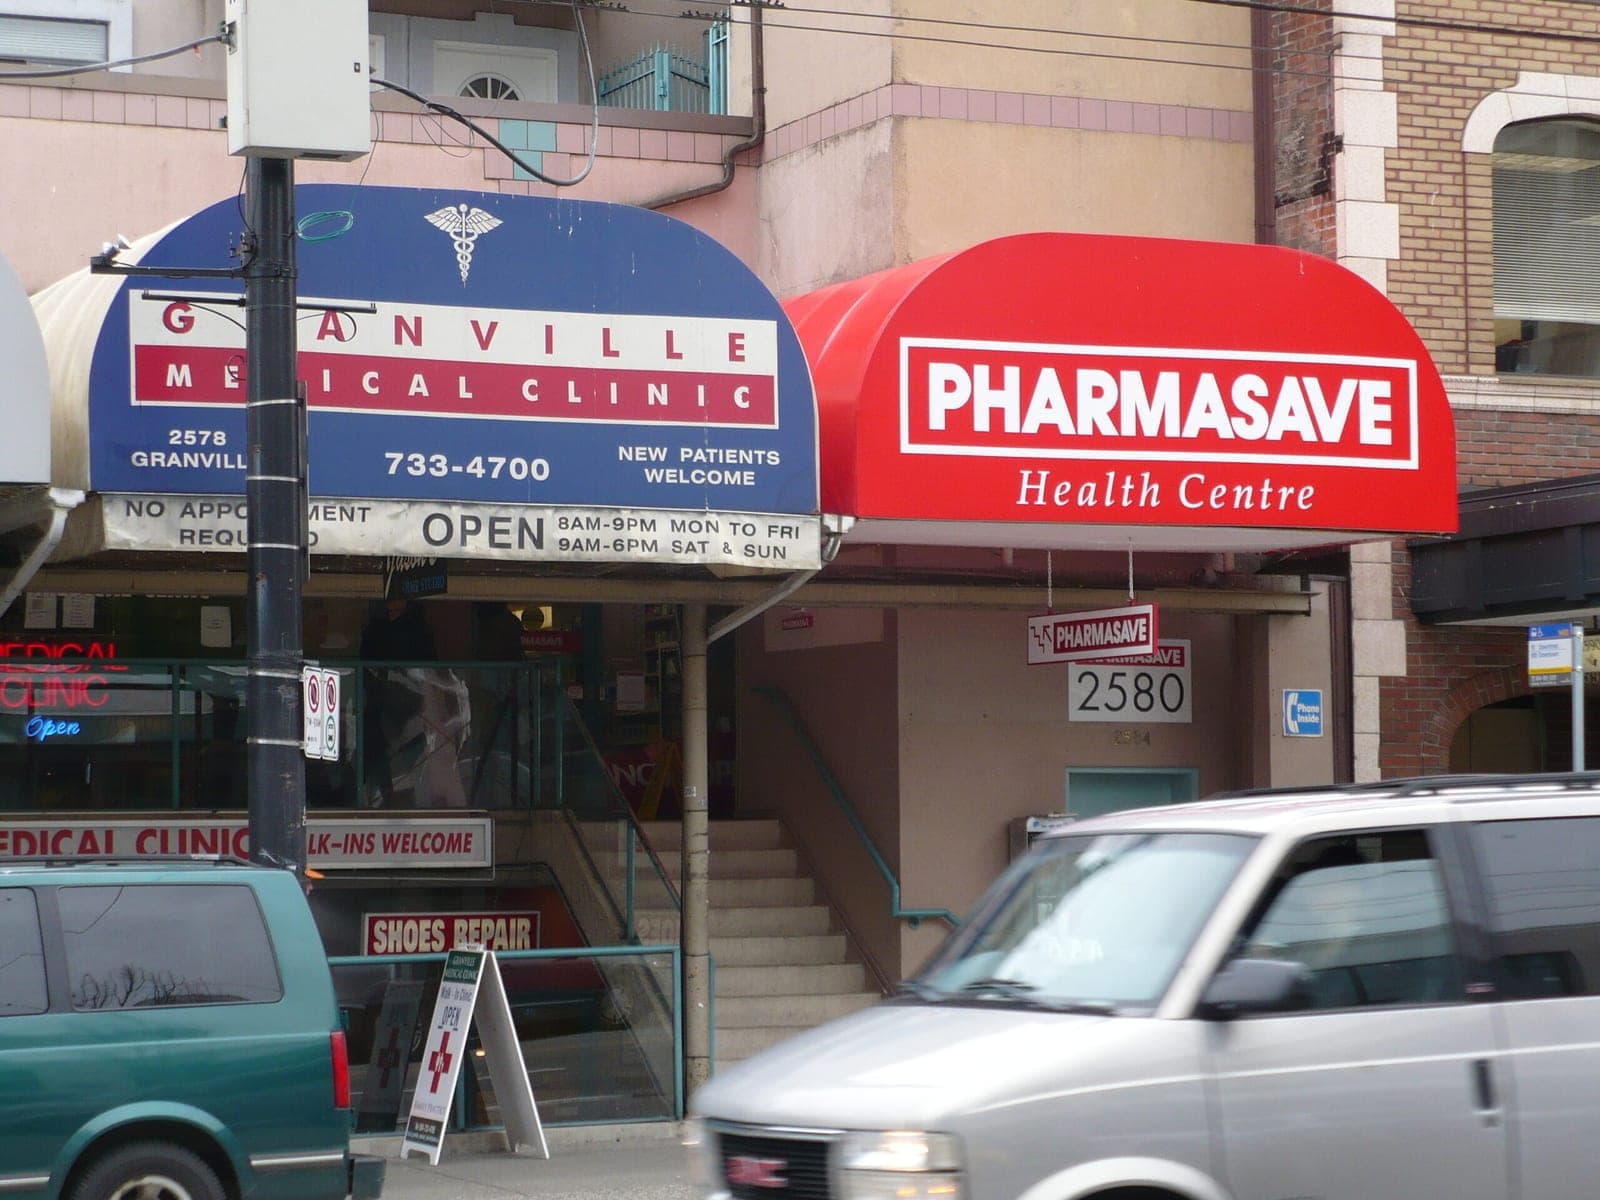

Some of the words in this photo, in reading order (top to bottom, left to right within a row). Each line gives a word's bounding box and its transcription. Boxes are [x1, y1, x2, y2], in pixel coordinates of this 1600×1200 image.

[162, 301, 746, 362] GANVILLE
[166, 364, 473, 399] MEICAL
[521, 378, 750, 409] CLINIC
[927, 361, 1393, 446] PHARMASAVE
[168, 430, 227, 446] 2578
[130, 451, 248, 470] GRANVILL
[384, 452, 550, 482] 733-4700
[618, 446, 667, 462] NEW
[680, 447, 781, 466] PATIENTS
[644, 468, 756, 487] WELCOME
[1016, 469, 1161, 507] Health
[1178, 473, 1315, 511] Centre
[125, 500, 165, 519] NO
[179, 501, 371, 523] APPOMENT
[179, 528, 319, 547] REQUD
[422, 512, 545, 550] OPEN
[557, 515, 657, 533] 8AM-9PM
[670, 519, 720, 535] MON
[729, 522, 757, 537] TO
[767, 524, 800, 540] FRI
[558, 537, 659, 554] 9AM-6PM
[671, 540, 710, 556] SAT
[722, 541, 733, 555] &
[743, 543, 787, 560] SUN
[1056, 617, 1147, 649] PHARMASAVE
[0, 641, 129, 673] EDICAL
[0, 674, 110, 708] CLINIC
[1077, 670, 1185, 713] 2580
[1297, 703, 1320, 713] Phone
[25, 715, 81, 742] Open
[0, 828, 114, 857] EDICAL
[135, 827, 249, 860] CLINIC
[307, 832, 376, 855] LK-INS
[381, 831, 473, 855] WELCOME
[373, 918, 446, 954] SHOES
[453, 917, 531, 951] REPAIR
[441, 1005, 462, 1027] OPEN
